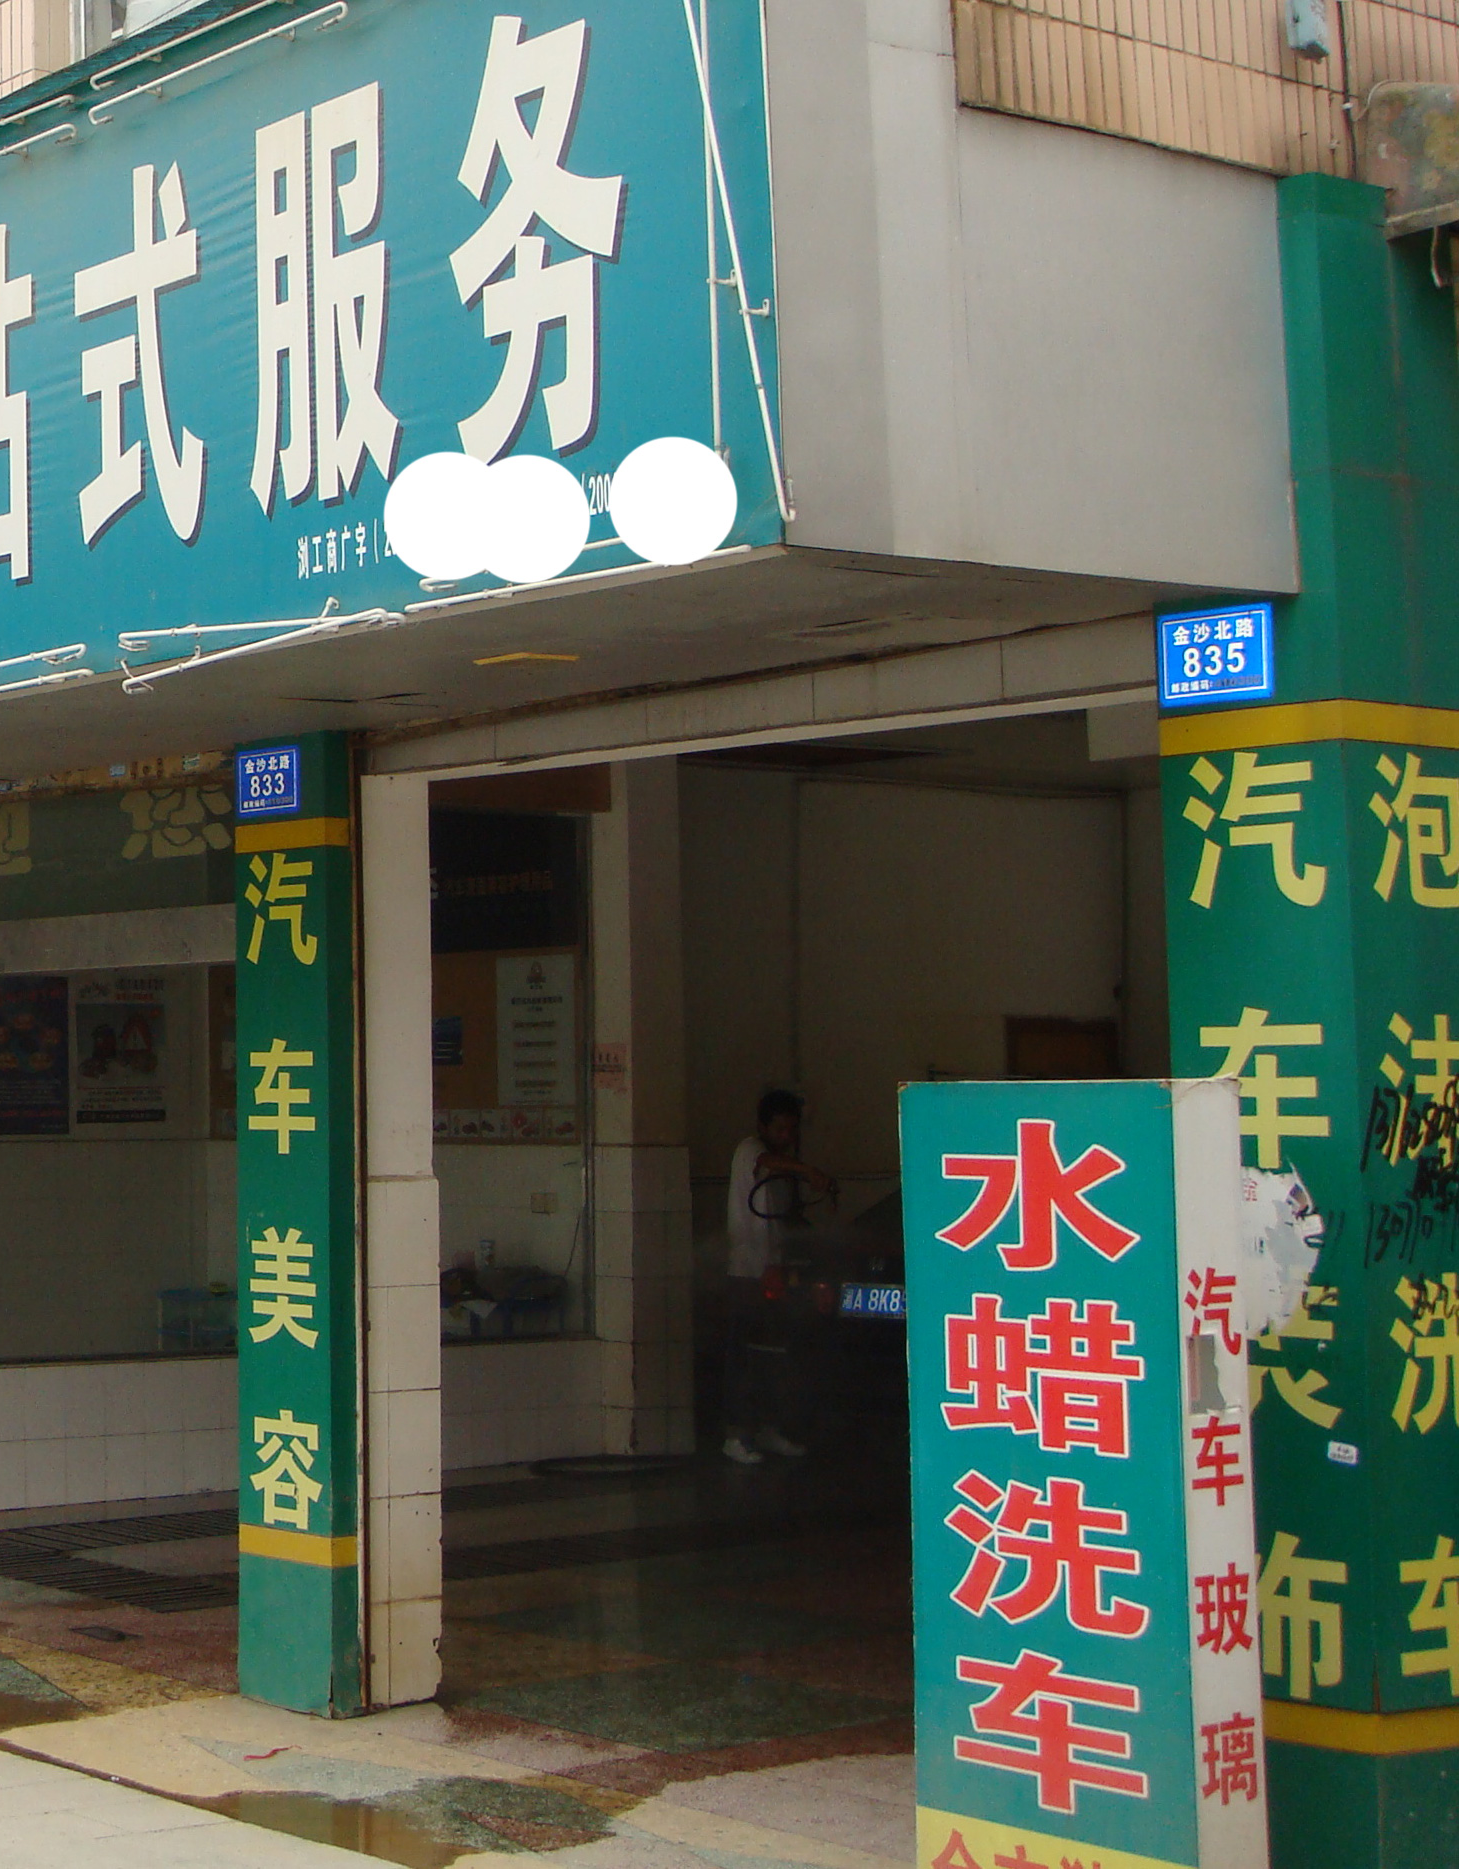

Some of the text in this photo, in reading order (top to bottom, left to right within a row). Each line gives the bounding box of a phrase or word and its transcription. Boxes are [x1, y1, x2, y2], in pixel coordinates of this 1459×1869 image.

[1172, 617, 1254, 646] 金沙北路
[1183, 642, 1245, 678] 835
[245, 755, 290, 774] 金沙北路
[250, 772, 285, 798] 833
[244, 852, 323, 1530] 汽车美容
[935, 1118, 1150, 1815] 水蜡洗车
[1184, 1266, 1260, 1806] 汽车玻璃
